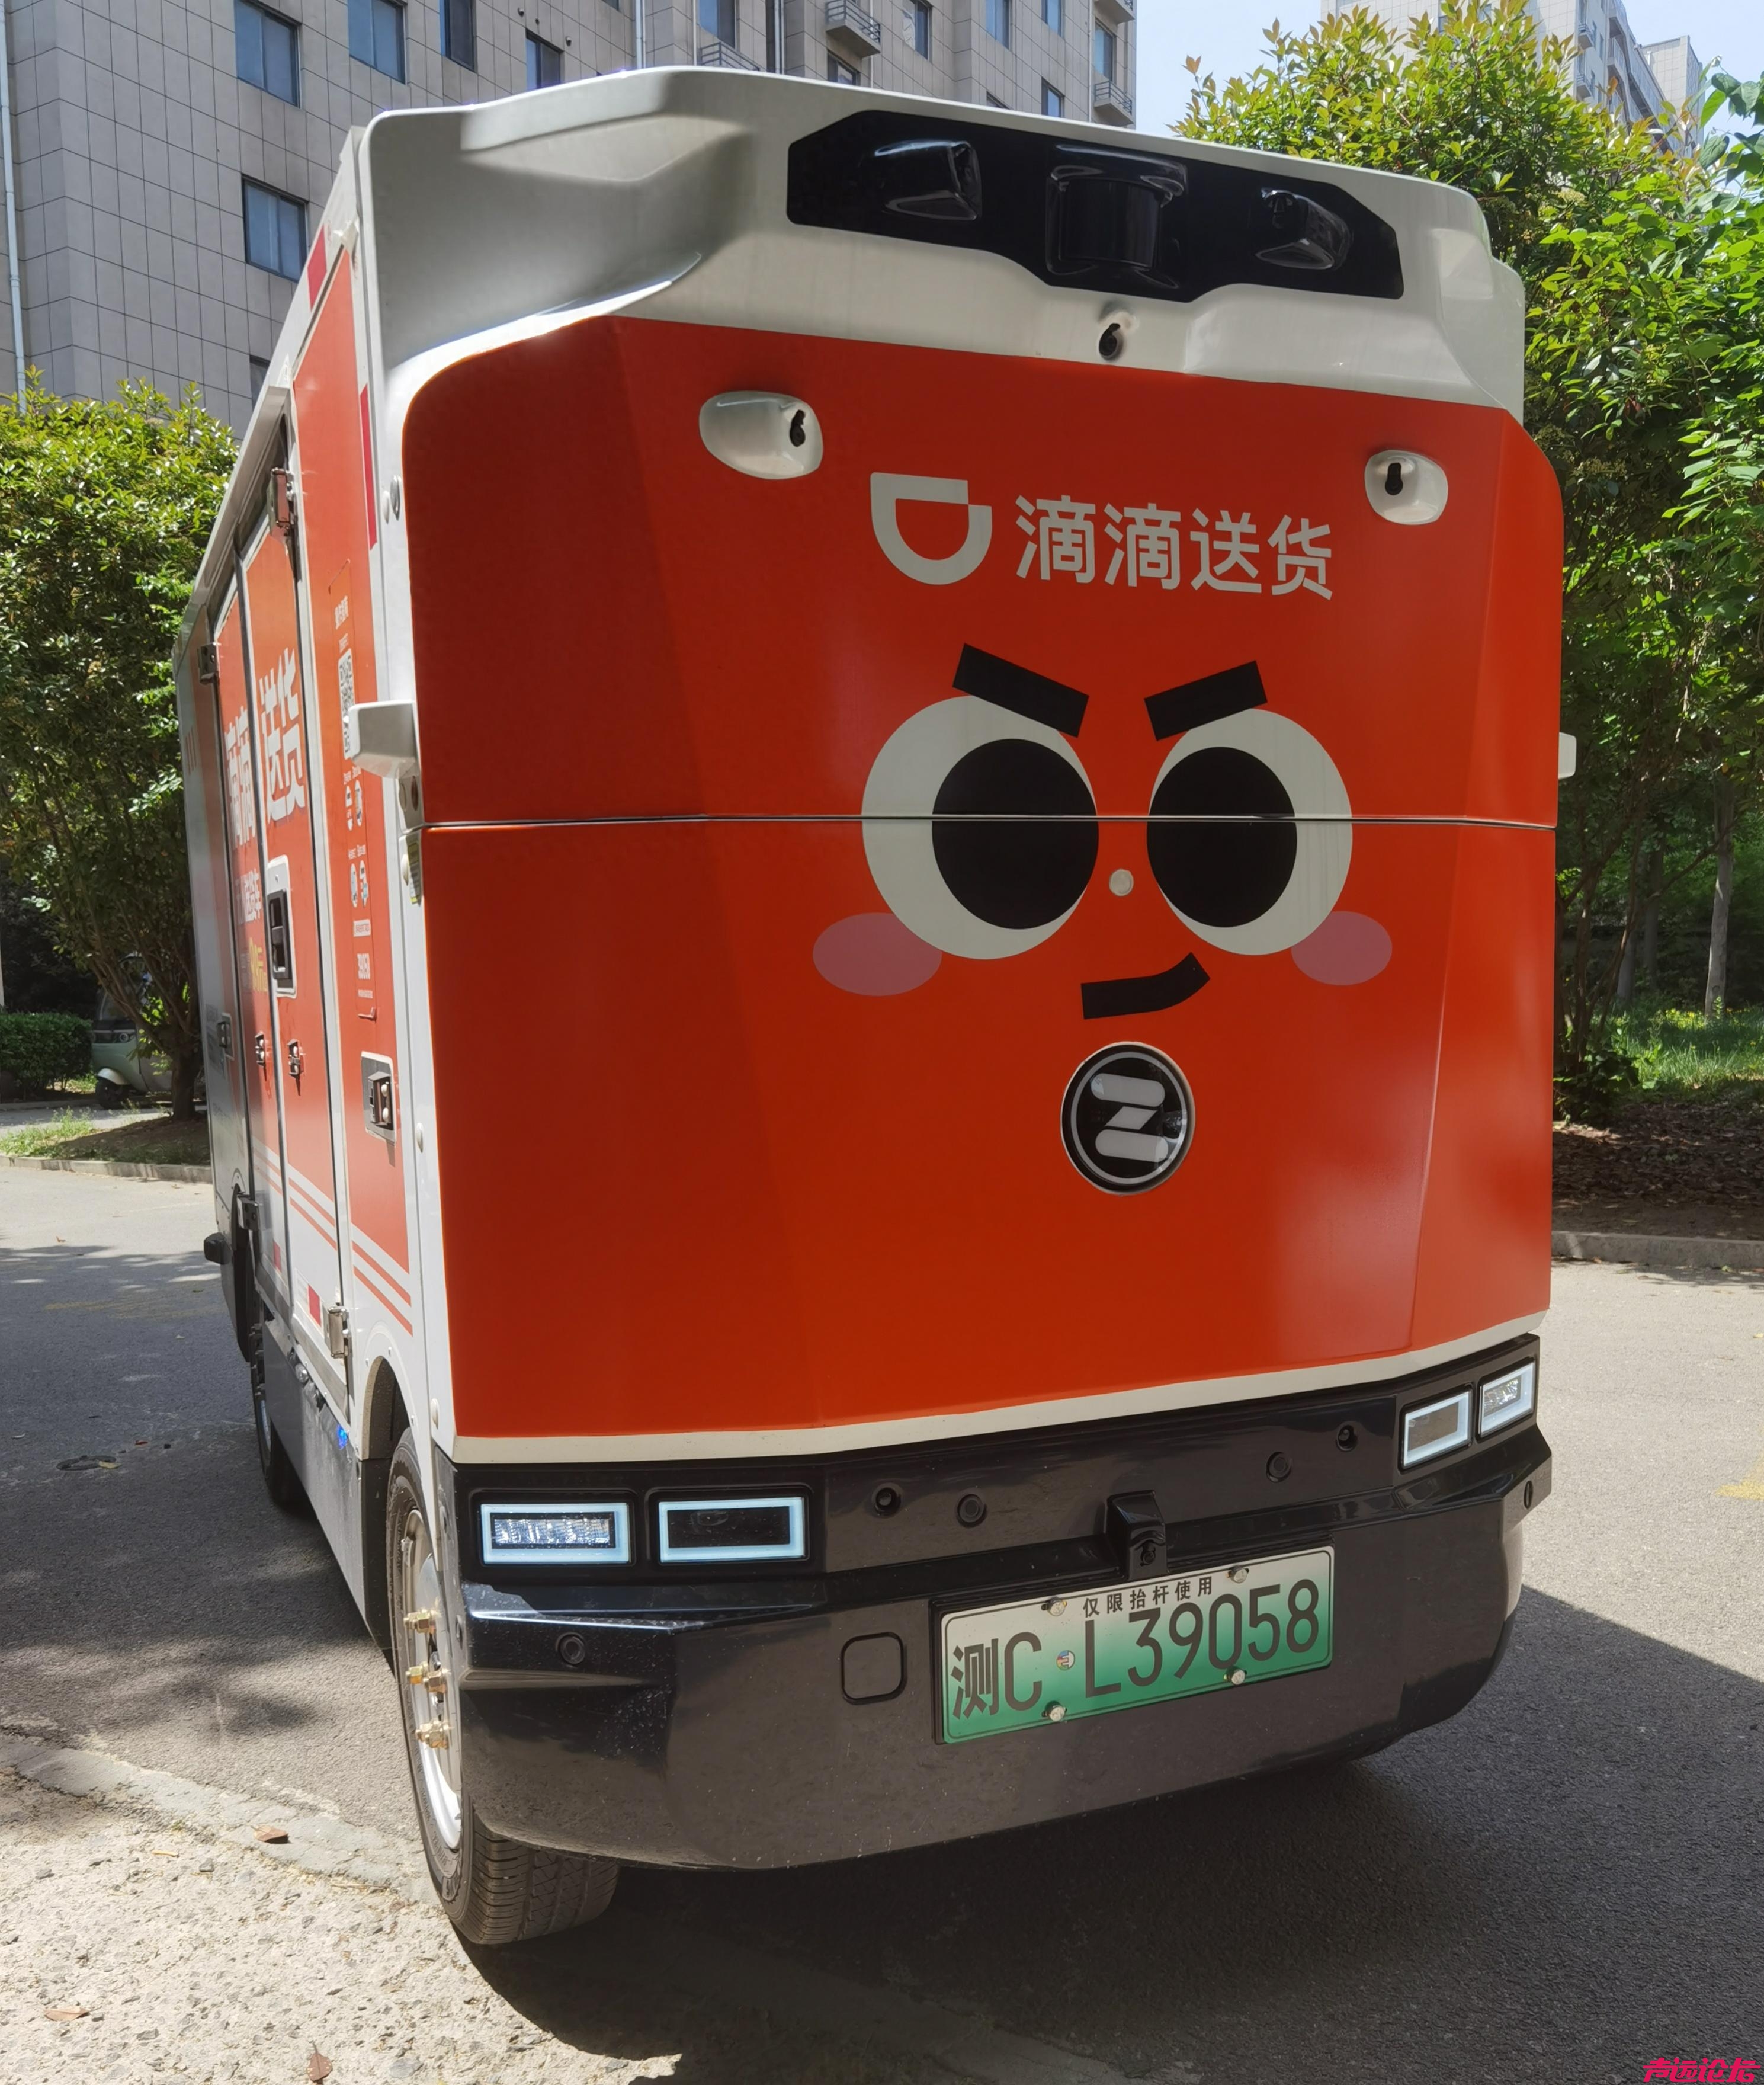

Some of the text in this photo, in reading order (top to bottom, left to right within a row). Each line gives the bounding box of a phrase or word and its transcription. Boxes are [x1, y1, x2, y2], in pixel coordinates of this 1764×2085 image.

[1015, 495, 1332, 600] 滴滴送货
[1083, 1576, 1213, 1619] 仅限抬杆使用
[1085, 1578, 1320, 1699] L39058
